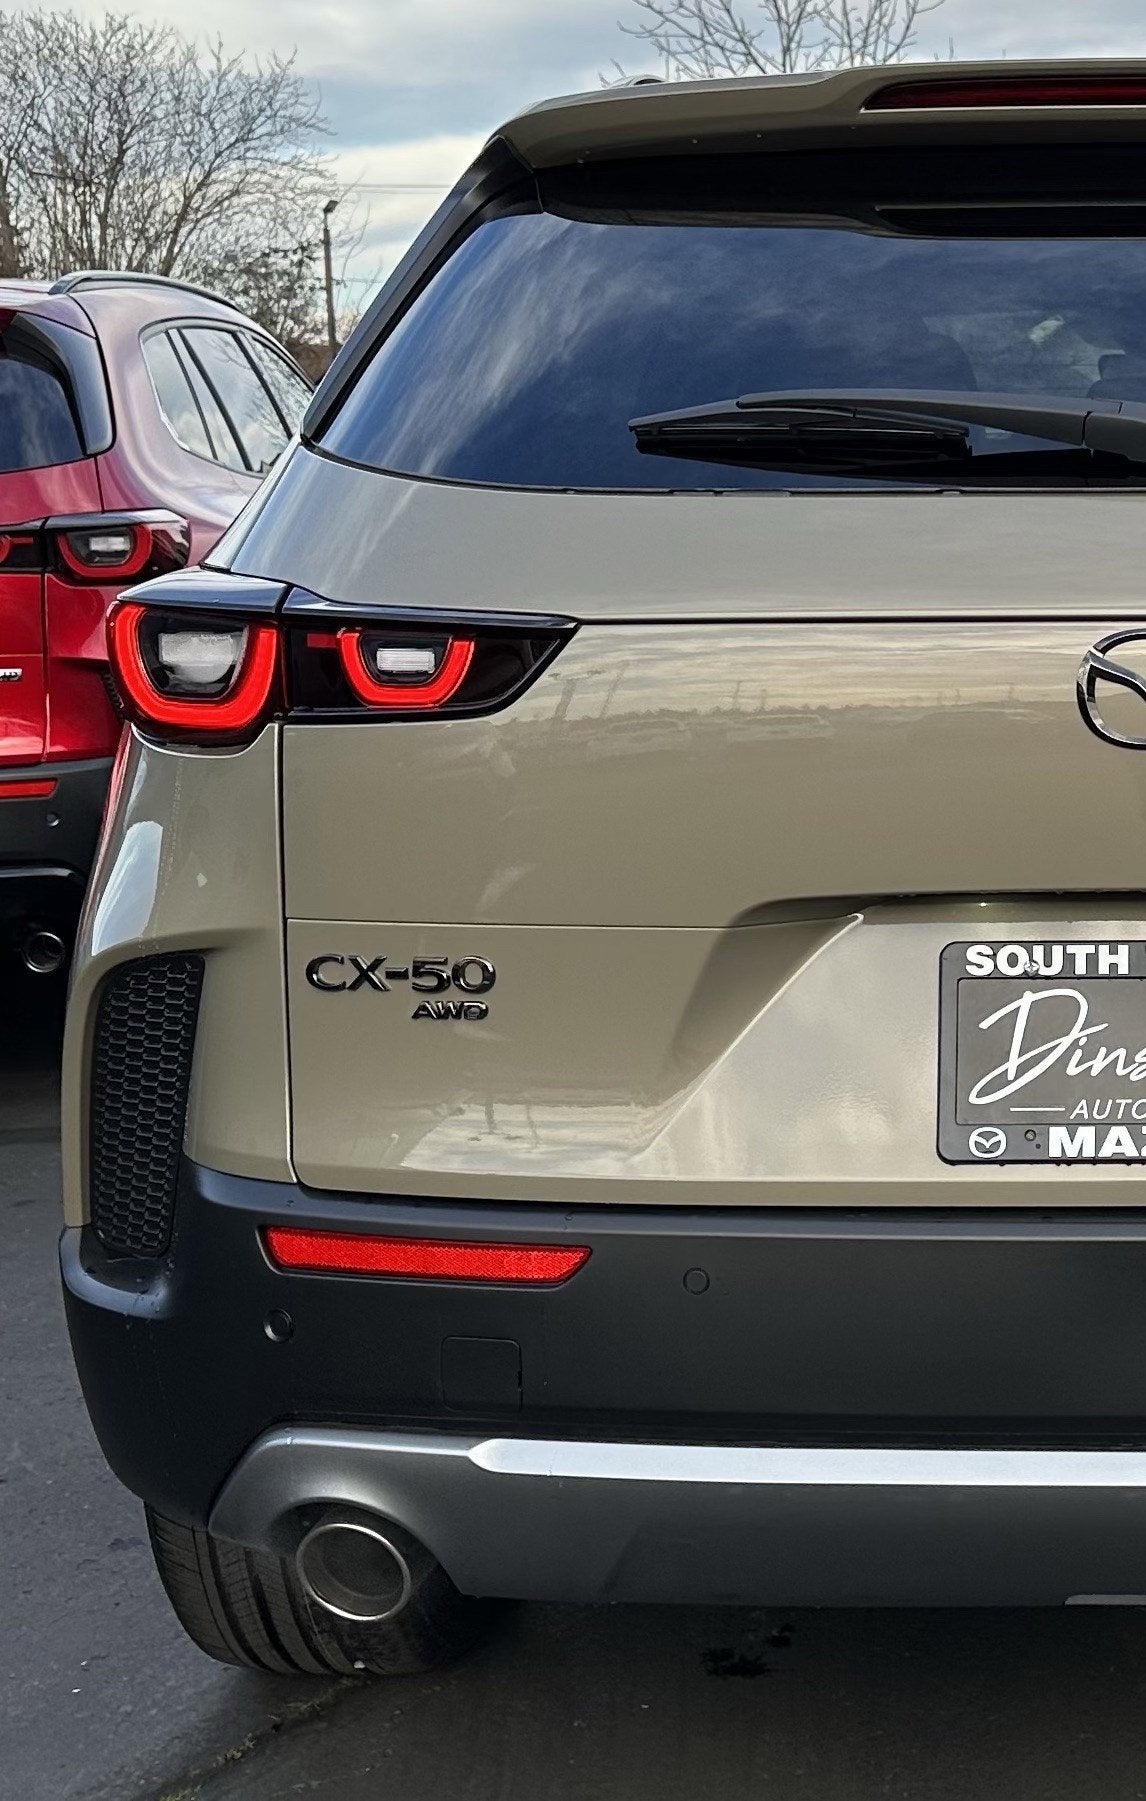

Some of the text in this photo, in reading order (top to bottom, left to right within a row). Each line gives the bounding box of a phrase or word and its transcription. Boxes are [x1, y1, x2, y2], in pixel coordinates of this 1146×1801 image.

[305, 953, 497, 994] CX-50
[965, 944, 1130, 976] SOUTH
[411, 1000, 490, 1021] AWD
